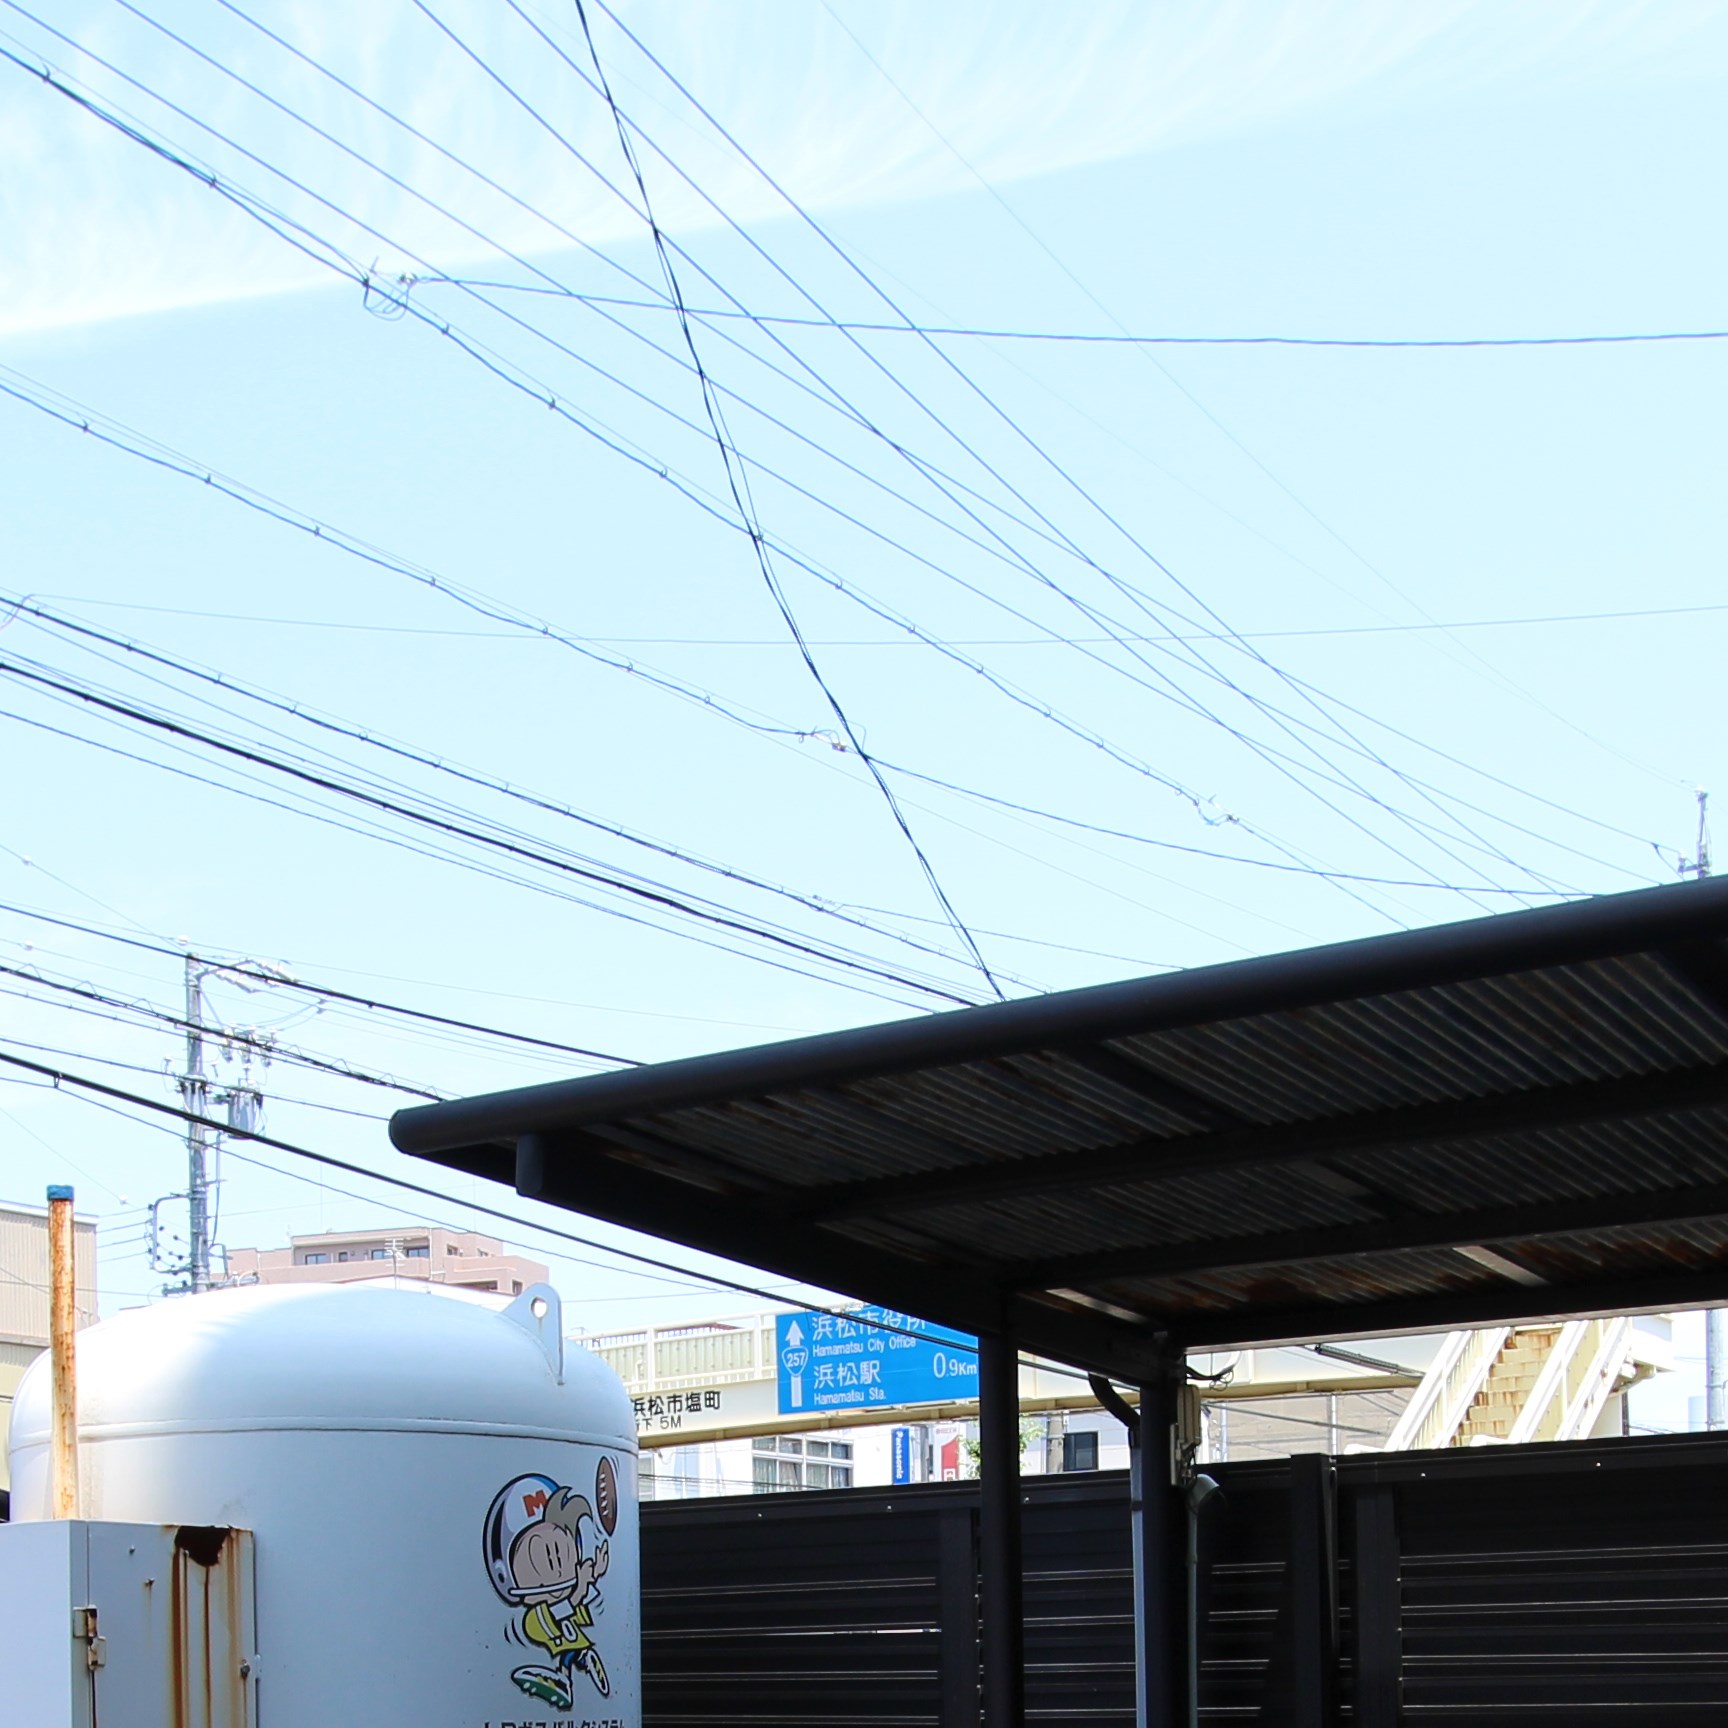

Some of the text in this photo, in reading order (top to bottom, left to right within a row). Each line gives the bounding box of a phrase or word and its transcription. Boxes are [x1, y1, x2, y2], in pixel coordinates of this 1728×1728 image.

[812, 1336, 917, 1358] Hamamatsu City Office
[786, 1352, 806, 1368] 257
[813, 1360, 882, 1389] 浜松駅
[813, 1387, 887, 1405] Hamamatsu Sta.
[895, 1430, 904, 1479] Panasonic
